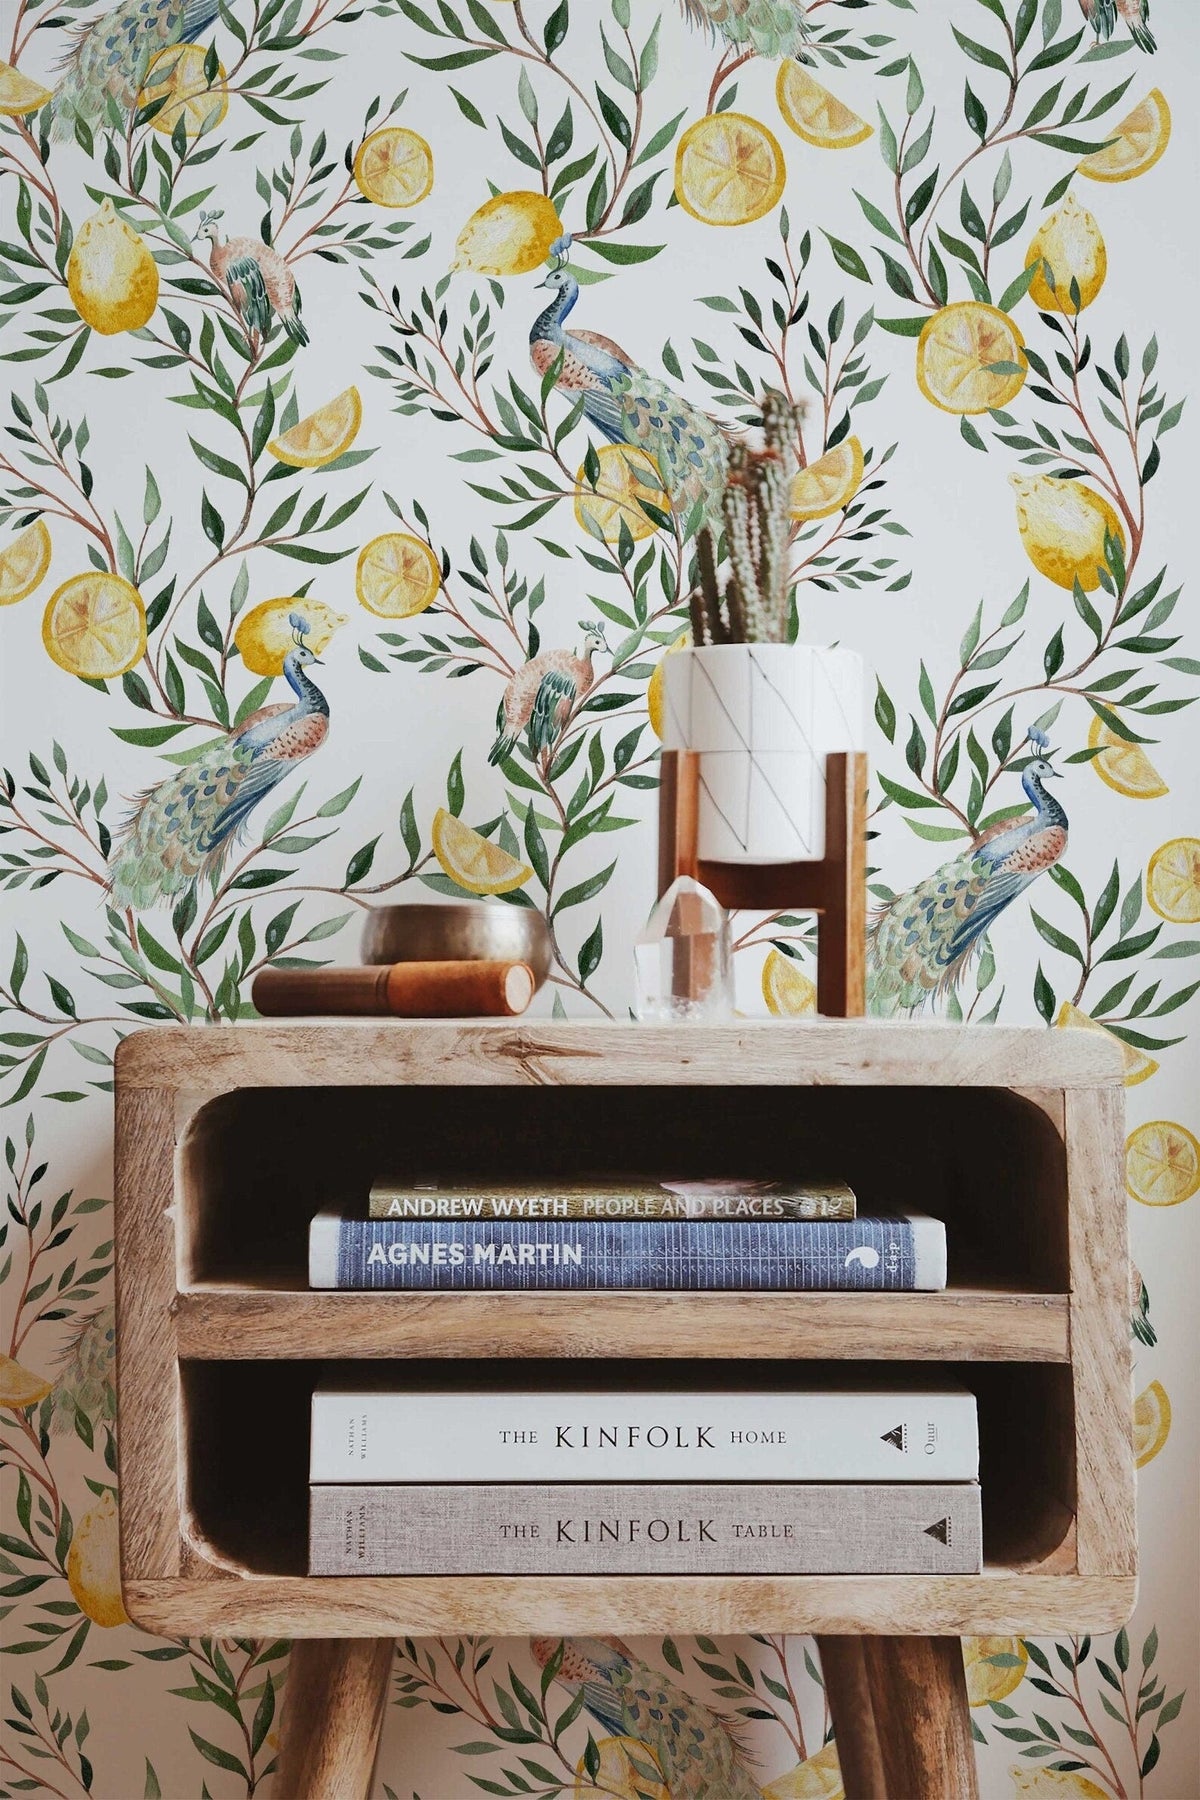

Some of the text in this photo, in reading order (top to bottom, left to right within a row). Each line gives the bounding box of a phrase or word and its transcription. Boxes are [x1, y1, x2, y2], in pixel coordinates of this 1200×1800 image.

[387, 1198, 785, 1216] ANDREW WYETH PEOPLE AND PLACES
[367, 1243, 582, 1265] AGNES MARTIN
[499, 1425, 788, 1448] THE KINFOLK HOME
[500, 1519, 794, 1542] THE KINFOLK TABLE
